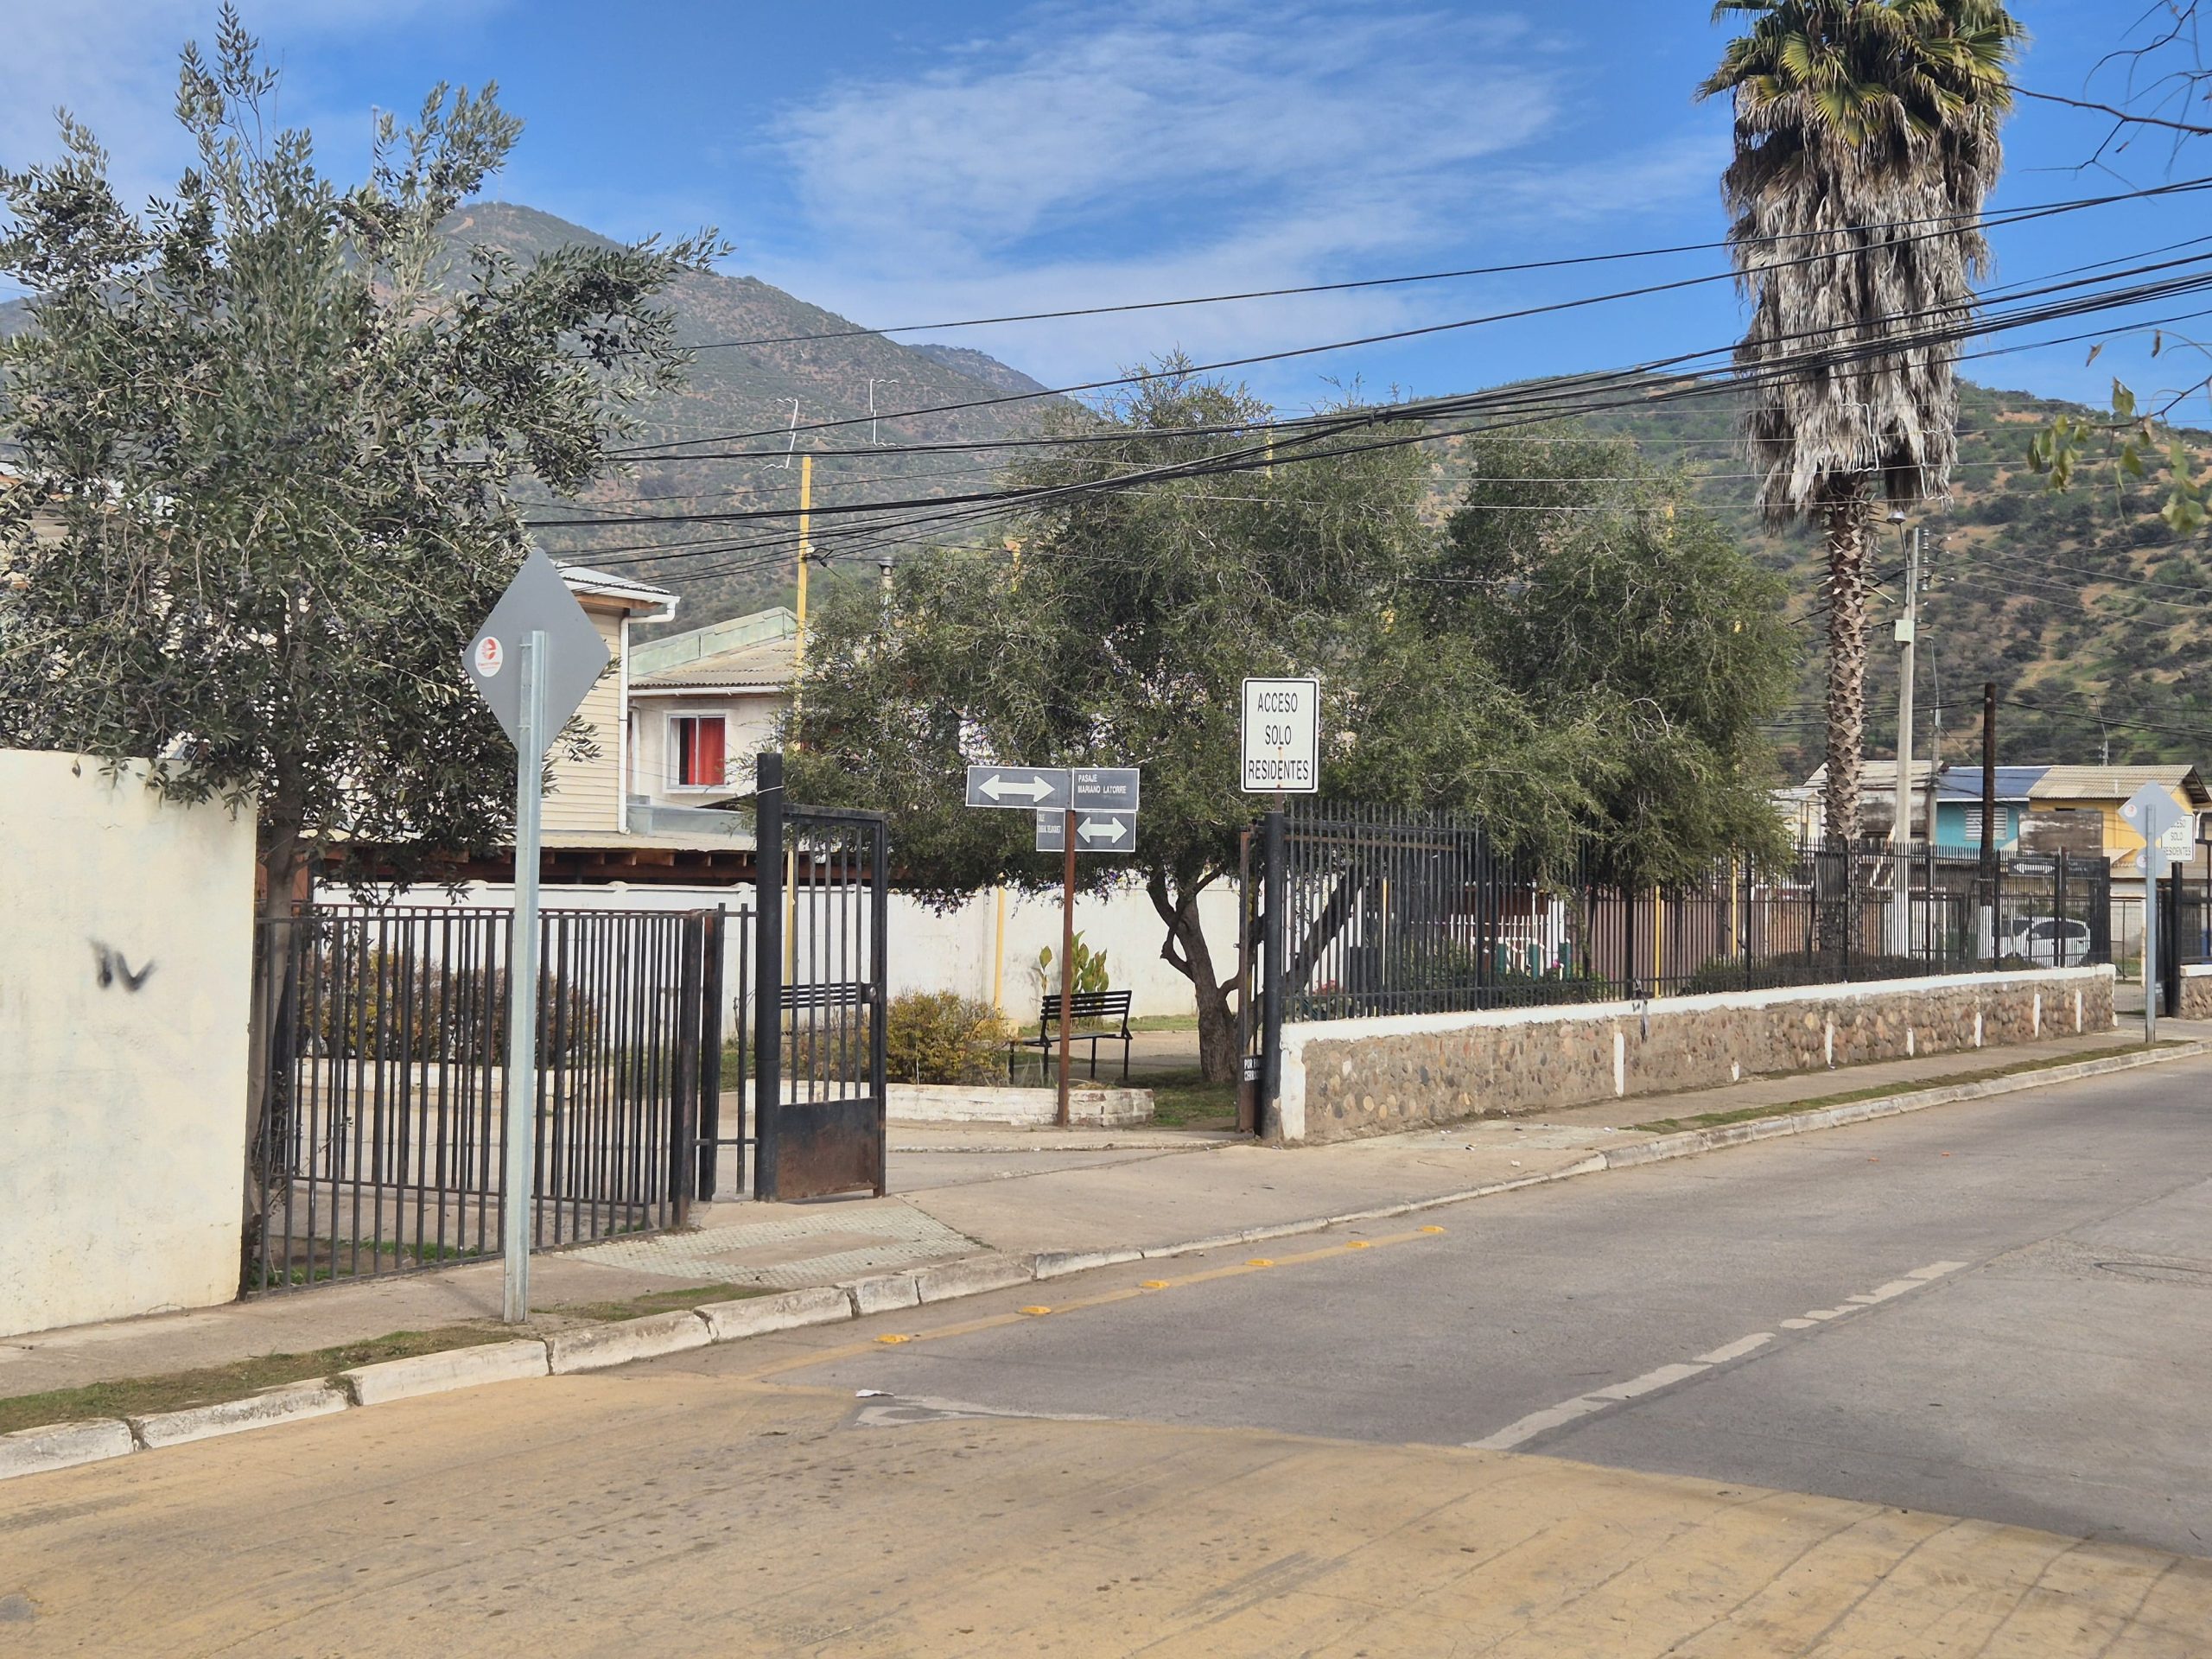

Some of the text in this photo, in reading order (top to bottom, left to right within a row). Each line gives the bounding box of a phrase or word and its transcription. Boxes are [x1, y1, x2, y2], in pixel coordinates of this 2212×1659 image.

[1257, 692, 1298, 713] ACCESO
[1264, 724, 1292, 746] SOLO
[1248, 760, 1309, 780] RESIDENTES
[1077, 774, 1097, 783] PASAJE
[1077, 785, 1127, 794] MARIANO LATORRE
[2171, 831, 2183, 841] SOLO
